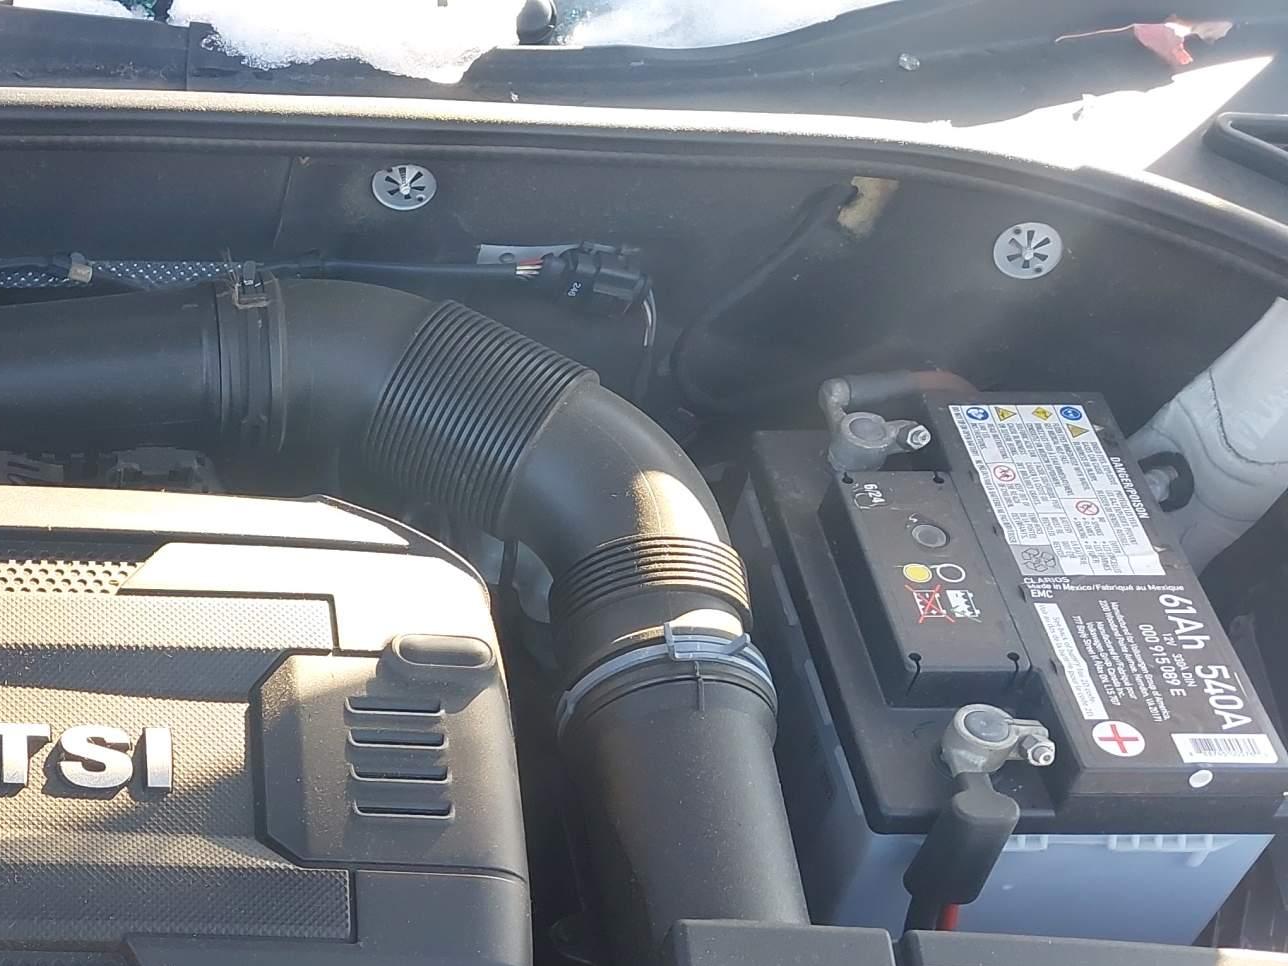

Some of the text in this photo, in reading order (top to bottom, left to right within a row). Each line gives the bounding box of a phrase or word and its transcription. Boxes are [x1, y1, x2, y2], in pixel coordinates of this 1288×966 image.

[1111, 457, 1150, 519] DANGER/POISON
[1031, 590, 1053, 598] EMC
[1137, 624, 1186, 696] 000 915 089 E
[1159, 593, 1210, 650] 61Ah
[1194, 665, 1253, 730] 540A
[1180, 672, 1197, 686] DIN
